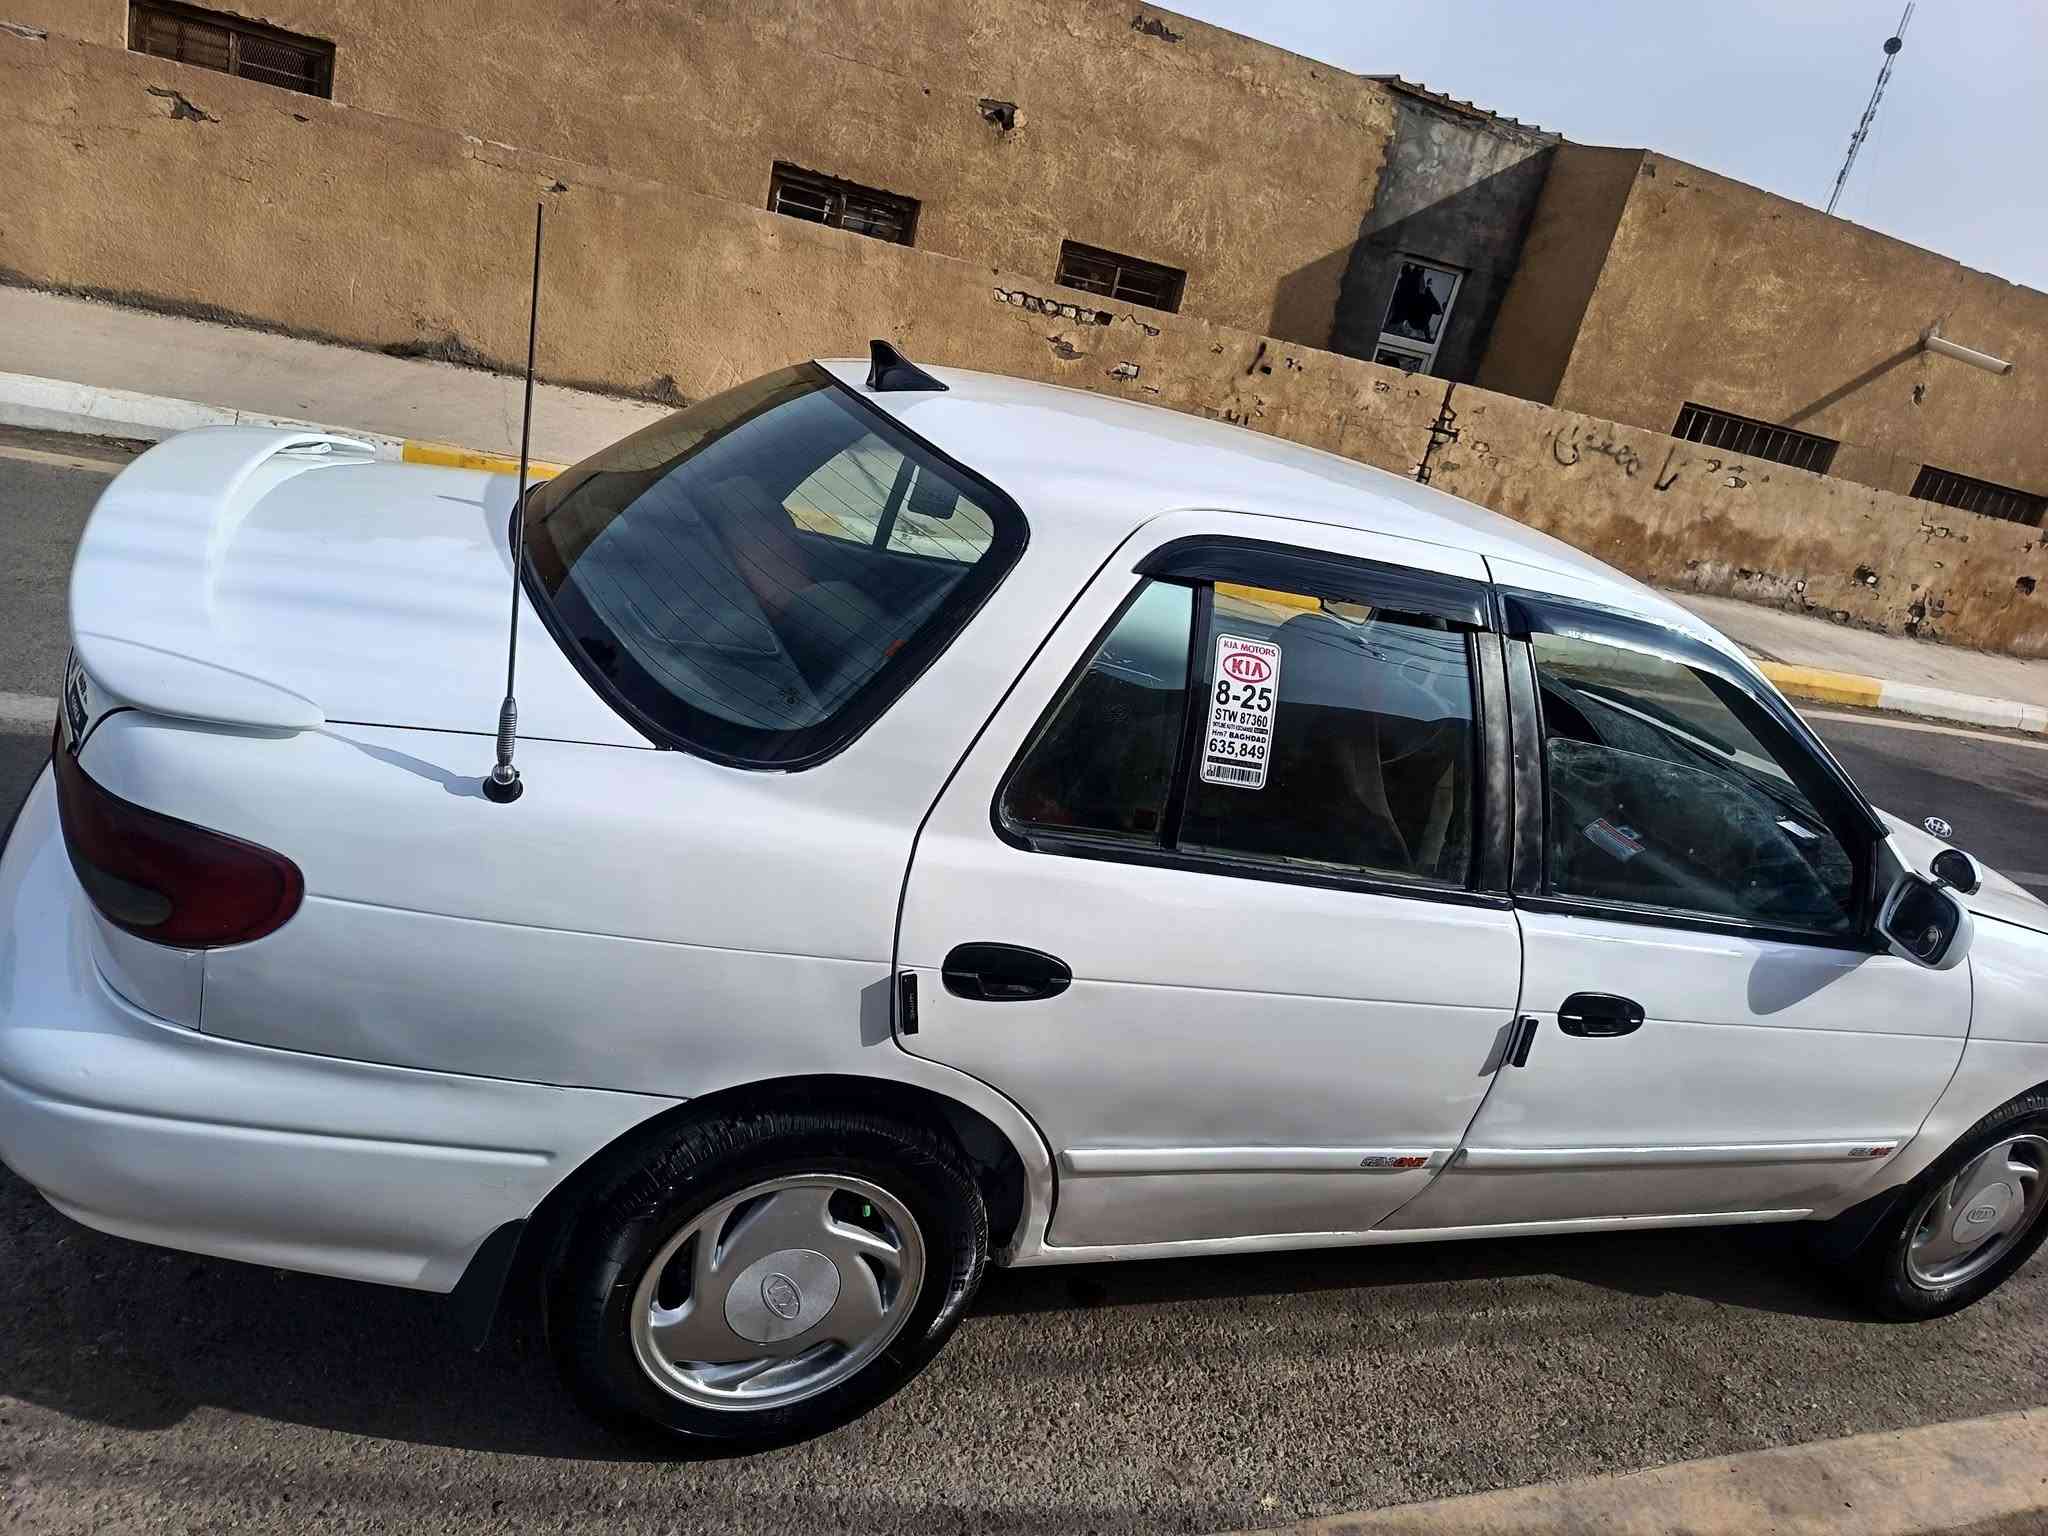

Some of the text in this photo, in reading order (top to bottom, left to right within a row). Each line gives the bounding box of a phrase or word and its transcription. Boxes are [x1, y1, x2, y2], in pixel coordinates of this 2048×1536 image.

[1223, 640, 1276, 657] KIA MOTORS
[1231, 658, 1264, 678] KIA
[1215, 680, 1273, 712] 8-25
[1214, 708, 1268, 728] STW 87360
[1229, 731, 1267, 744] BAGHDAD
[1208, 738, 1266, 760] 635,849
